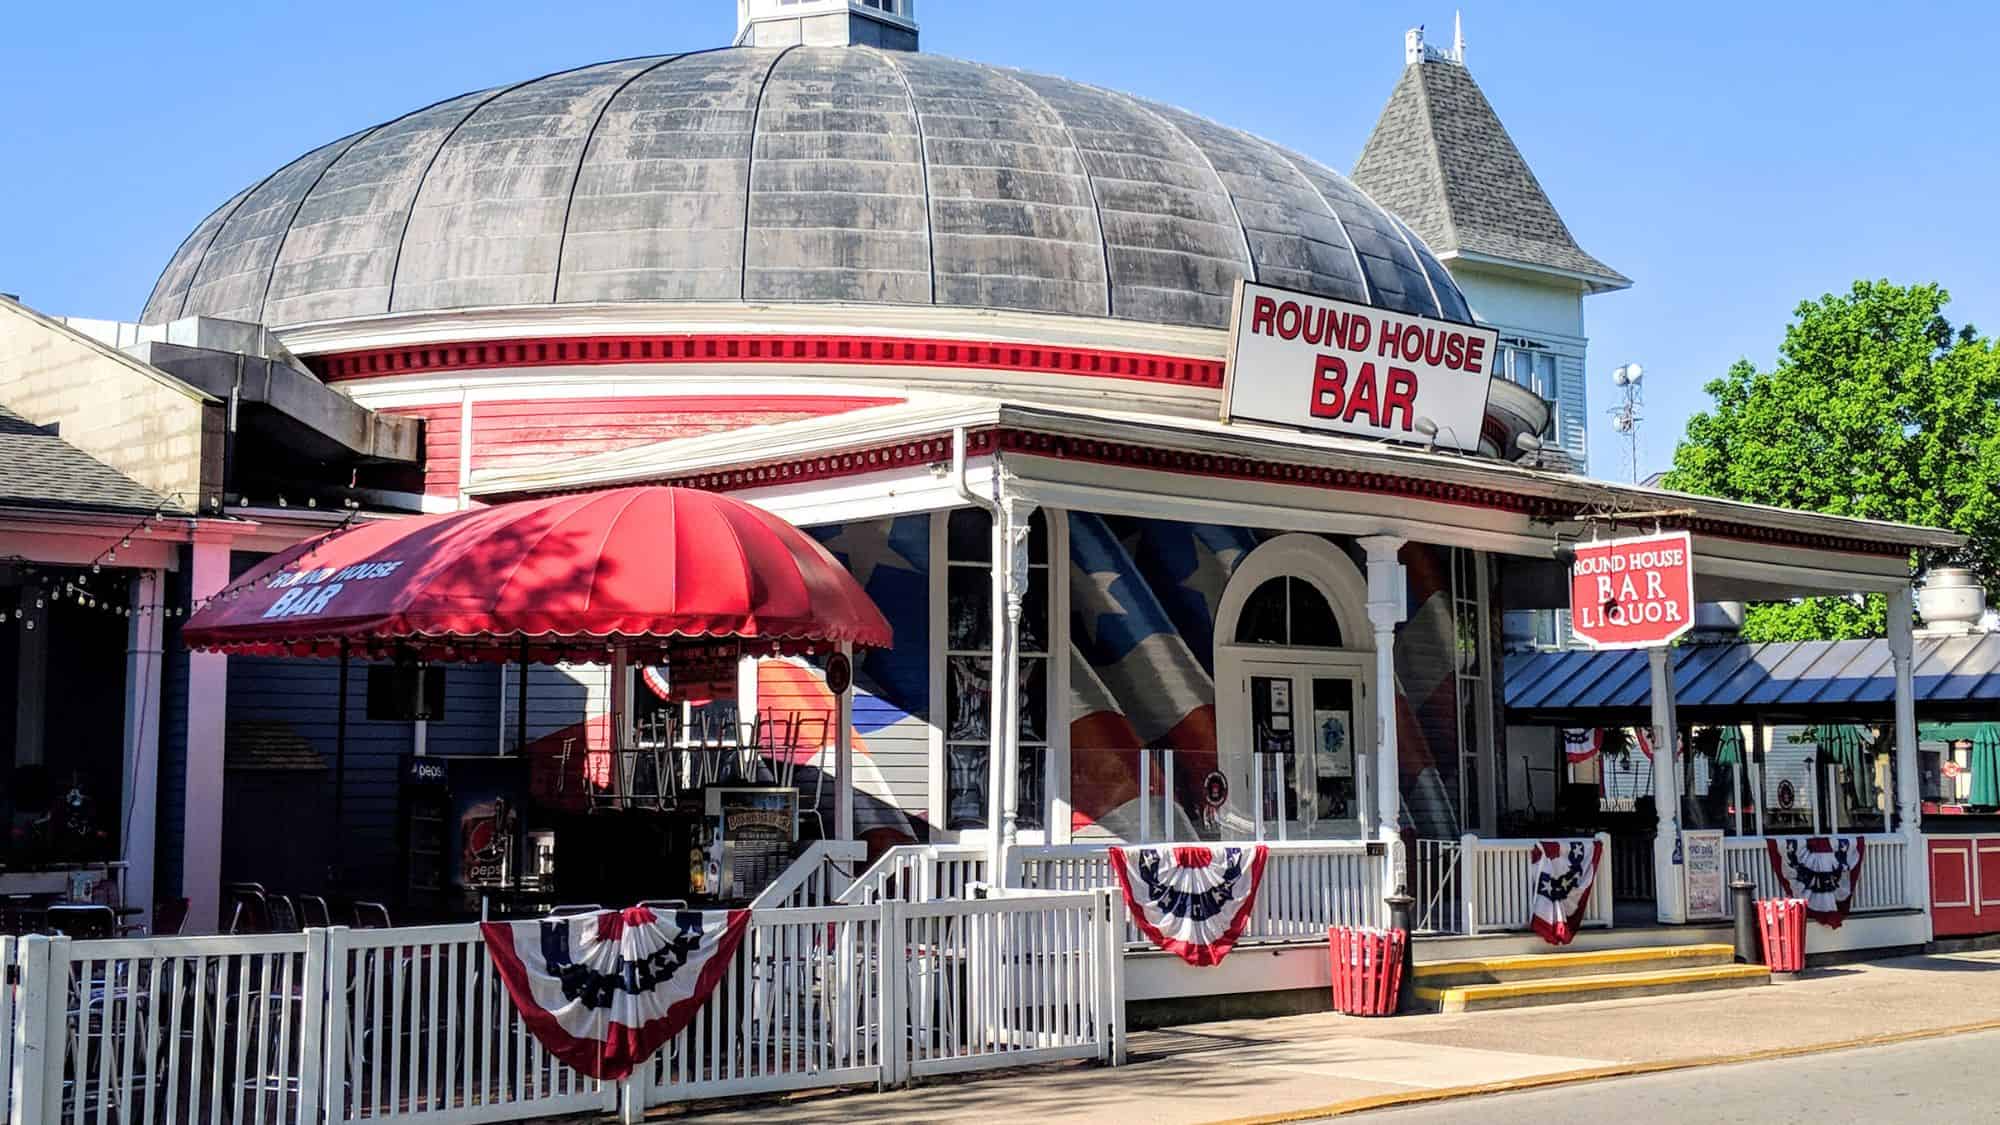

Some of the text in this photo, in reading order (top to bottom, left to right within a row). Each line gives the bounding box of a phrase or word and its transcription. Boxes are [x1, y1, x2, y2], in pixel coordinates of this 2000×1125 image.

[1252, 295, 1486, 373] ROUND HOUSE
[1309, 353, 1419, 432] BAR
[267, 560, 404, 589] ROUND HOUSE
[1574, 549, 1684, 577] ROUND HOUSE
[262, 583, 344, 618] BAR
[1597, 571, 1666, 604] BAR
[1582, 600, 1682, 628] LIQUOR
[471, 864, 504, 879] peps
